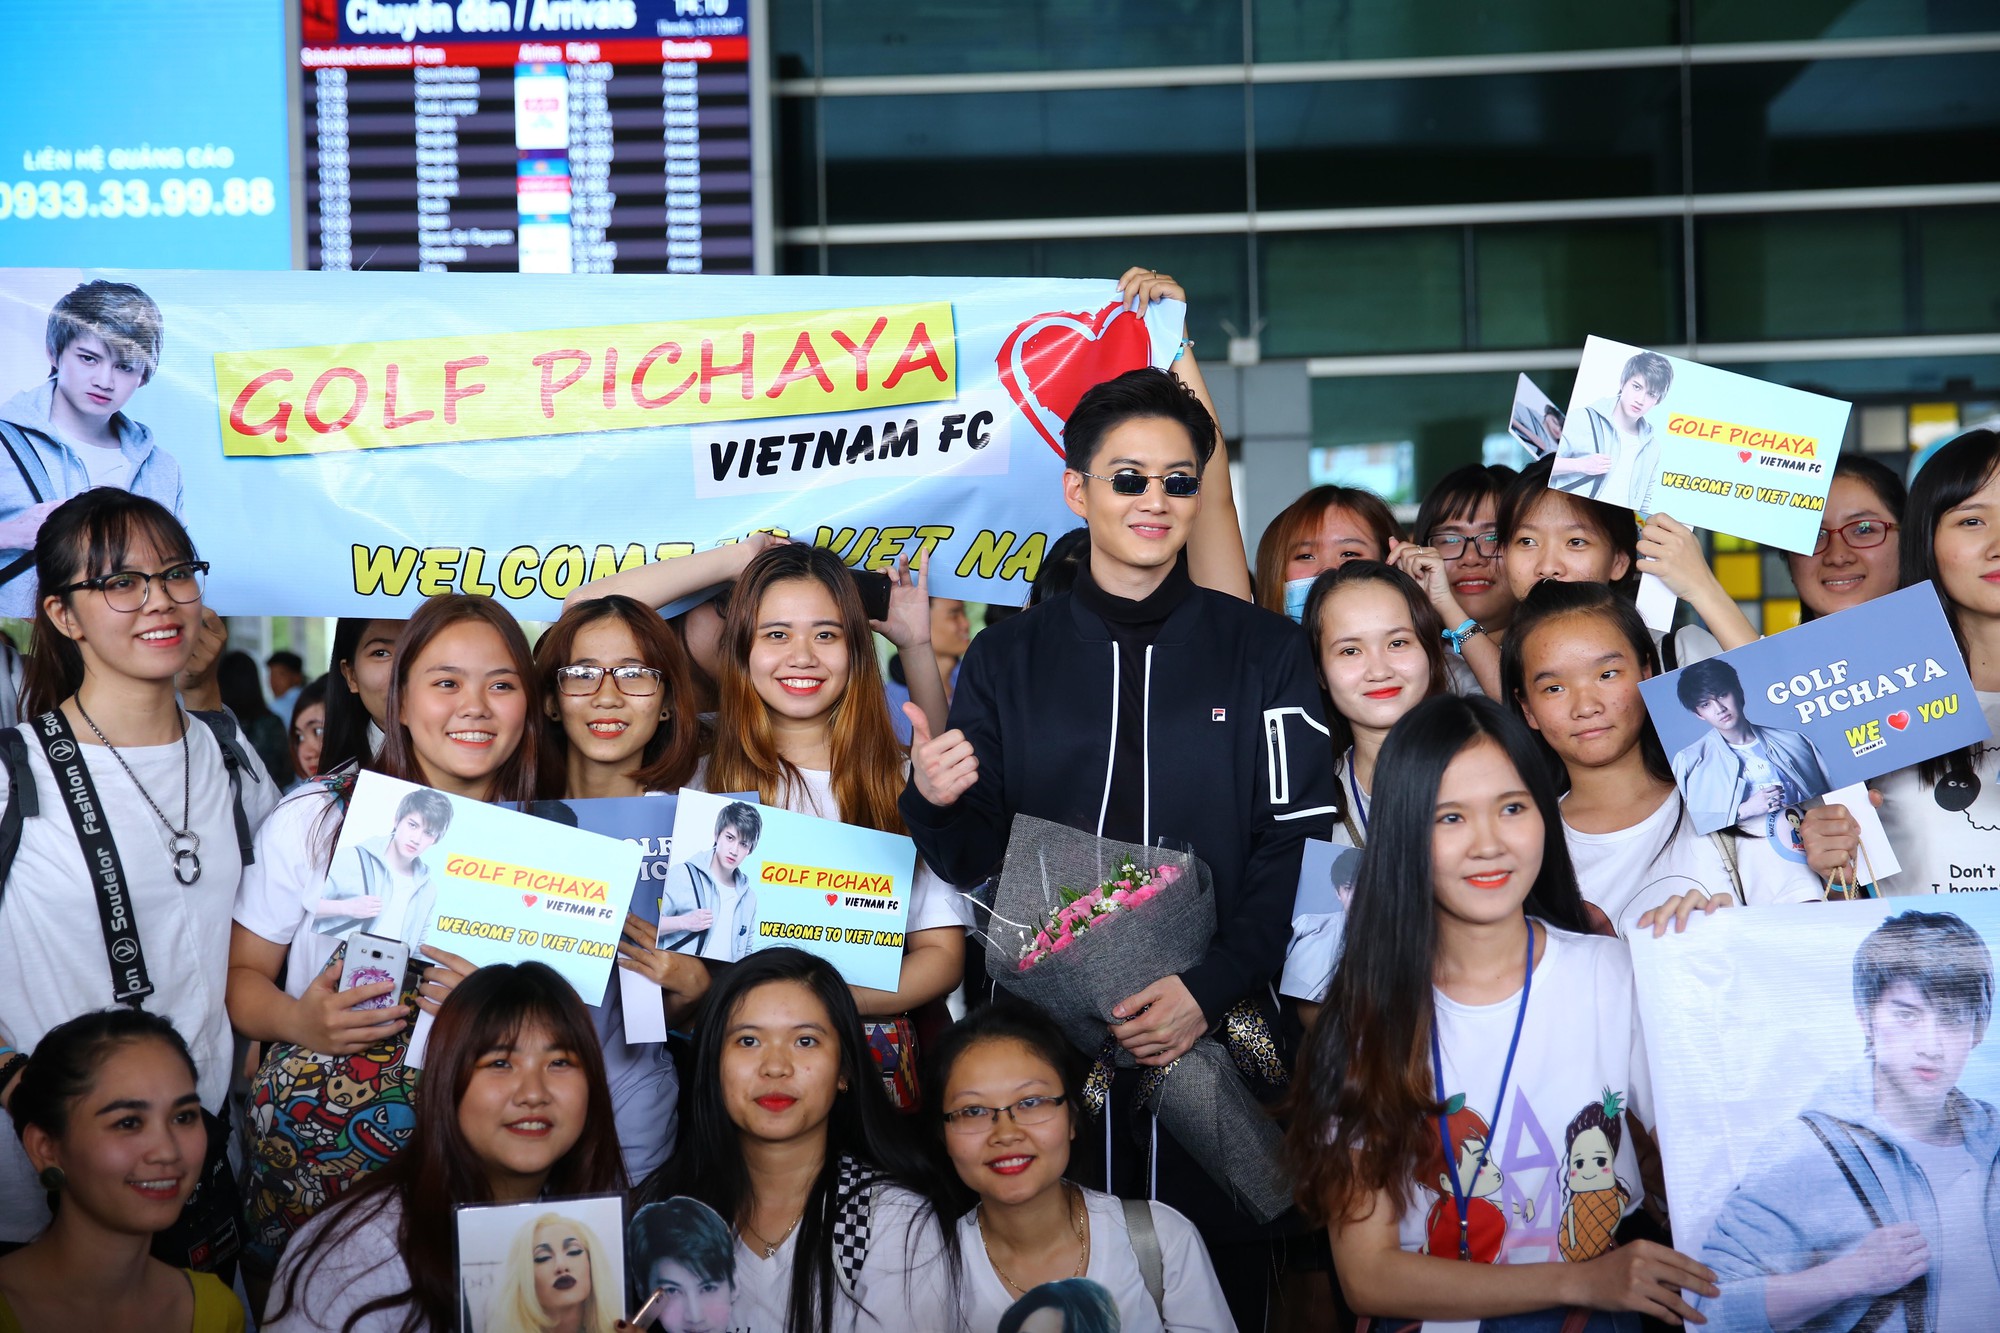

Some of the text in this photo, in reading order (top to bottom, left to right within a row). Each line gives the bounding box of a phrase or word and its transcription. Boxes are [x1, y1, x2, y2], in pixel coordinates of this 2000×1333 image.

[229, 316, 948, 443] GOLF PICHAYA
[710, 410, 995, 481] VIETNAM FC
[1668, 417, 1815, 456] GOLF PICHAYA
[1759, 455, 1822, 474] VIETNAM FC
[1661, 472, 1825, 511] WELCOME TO VIET NAM
[1766, 659, 1848, 705] GOLF
[1795, 658, 1948, 724] PICHAYA
[1844, 694, 1958, 748] WE YOU
[1855, 743, 1877, 755] VIETNAM
[65, 764, 128, 932] Soudelor Fashion
[446, 858, 606, 901] GOLF PICHAYA
[761, 866, 892, 894] GOLF PICHAYA
[1950, 863, 1996, 878] Don't
[546, 900, 613, 919] VIETNAM FC
[845, 897, 898, 910] VIETNAM FC
[437, 915, 616, 959] WELCOME TO VIET NAM
[760, 921, 903, 947] WELCOME TO VIET NAM
